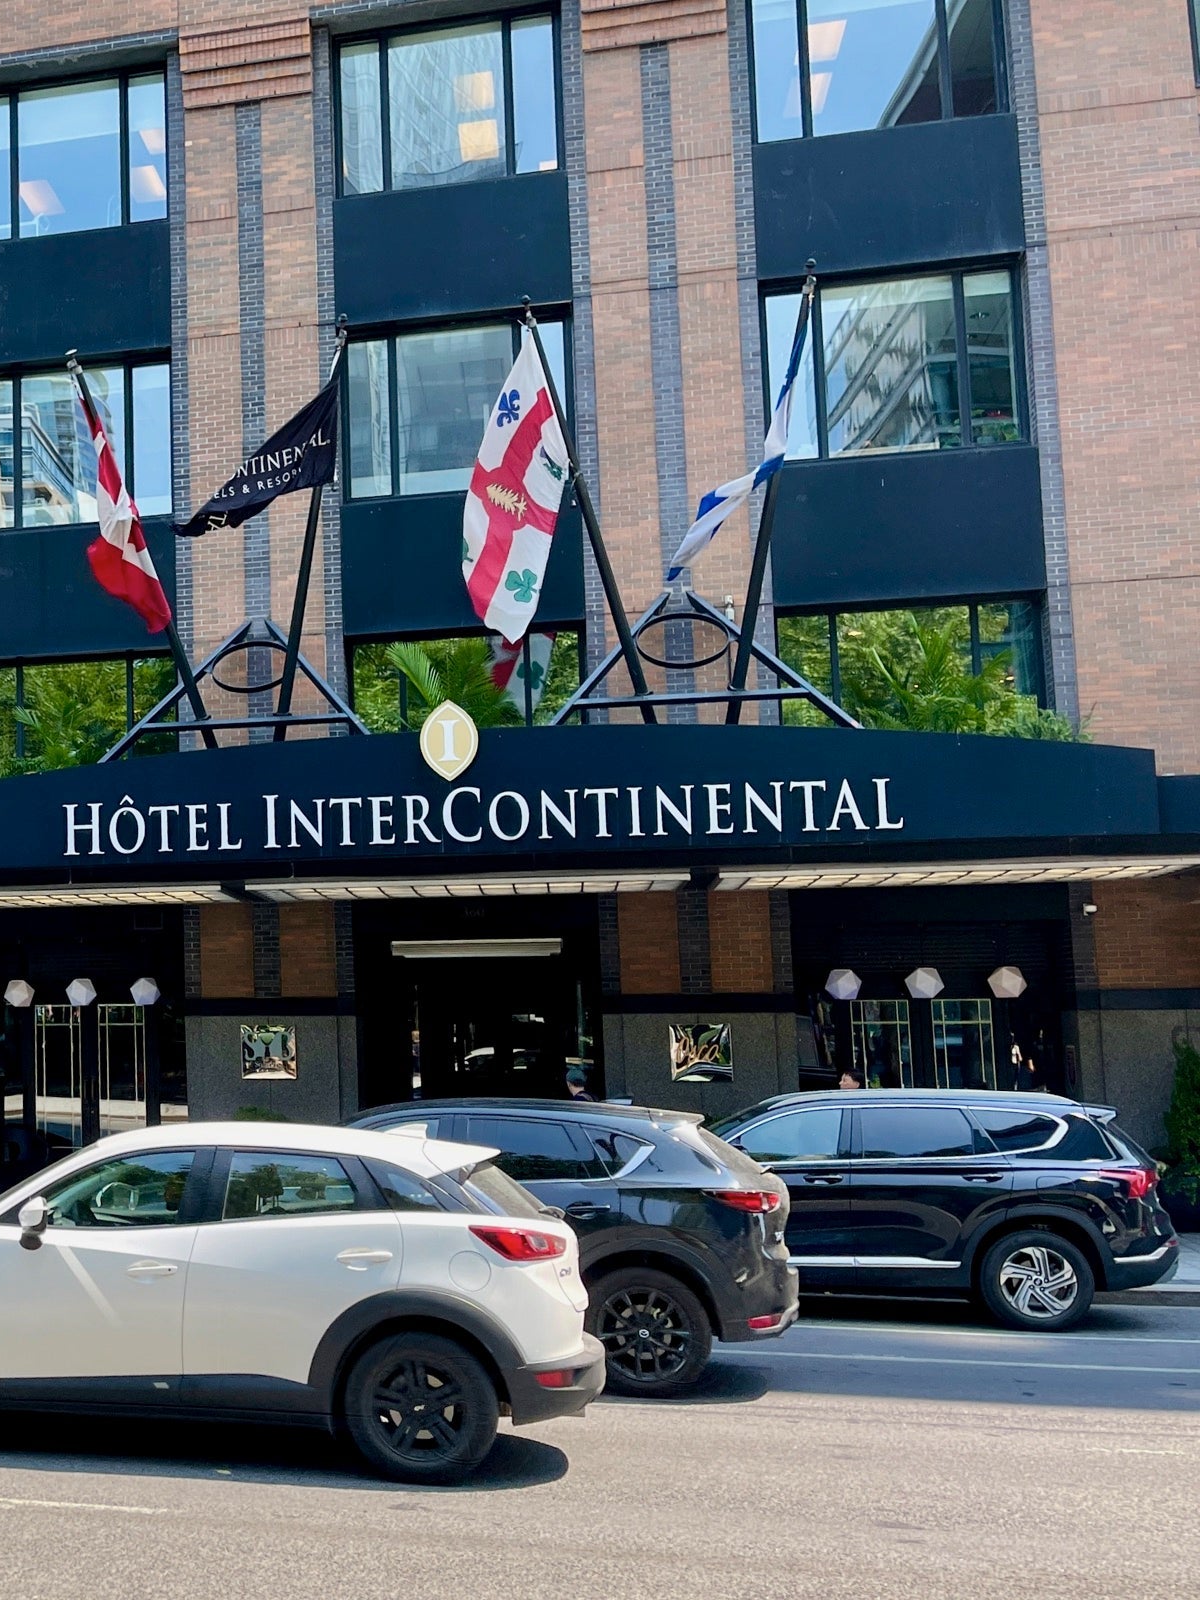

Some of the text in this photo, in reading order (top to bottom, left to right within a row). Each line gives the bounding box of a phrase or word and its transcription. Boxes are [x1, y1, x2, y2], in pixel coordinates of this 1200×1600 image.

[213, 468, 301, 499] ELS & RESOR
[62, 795, 242, 856] HÔTEL
